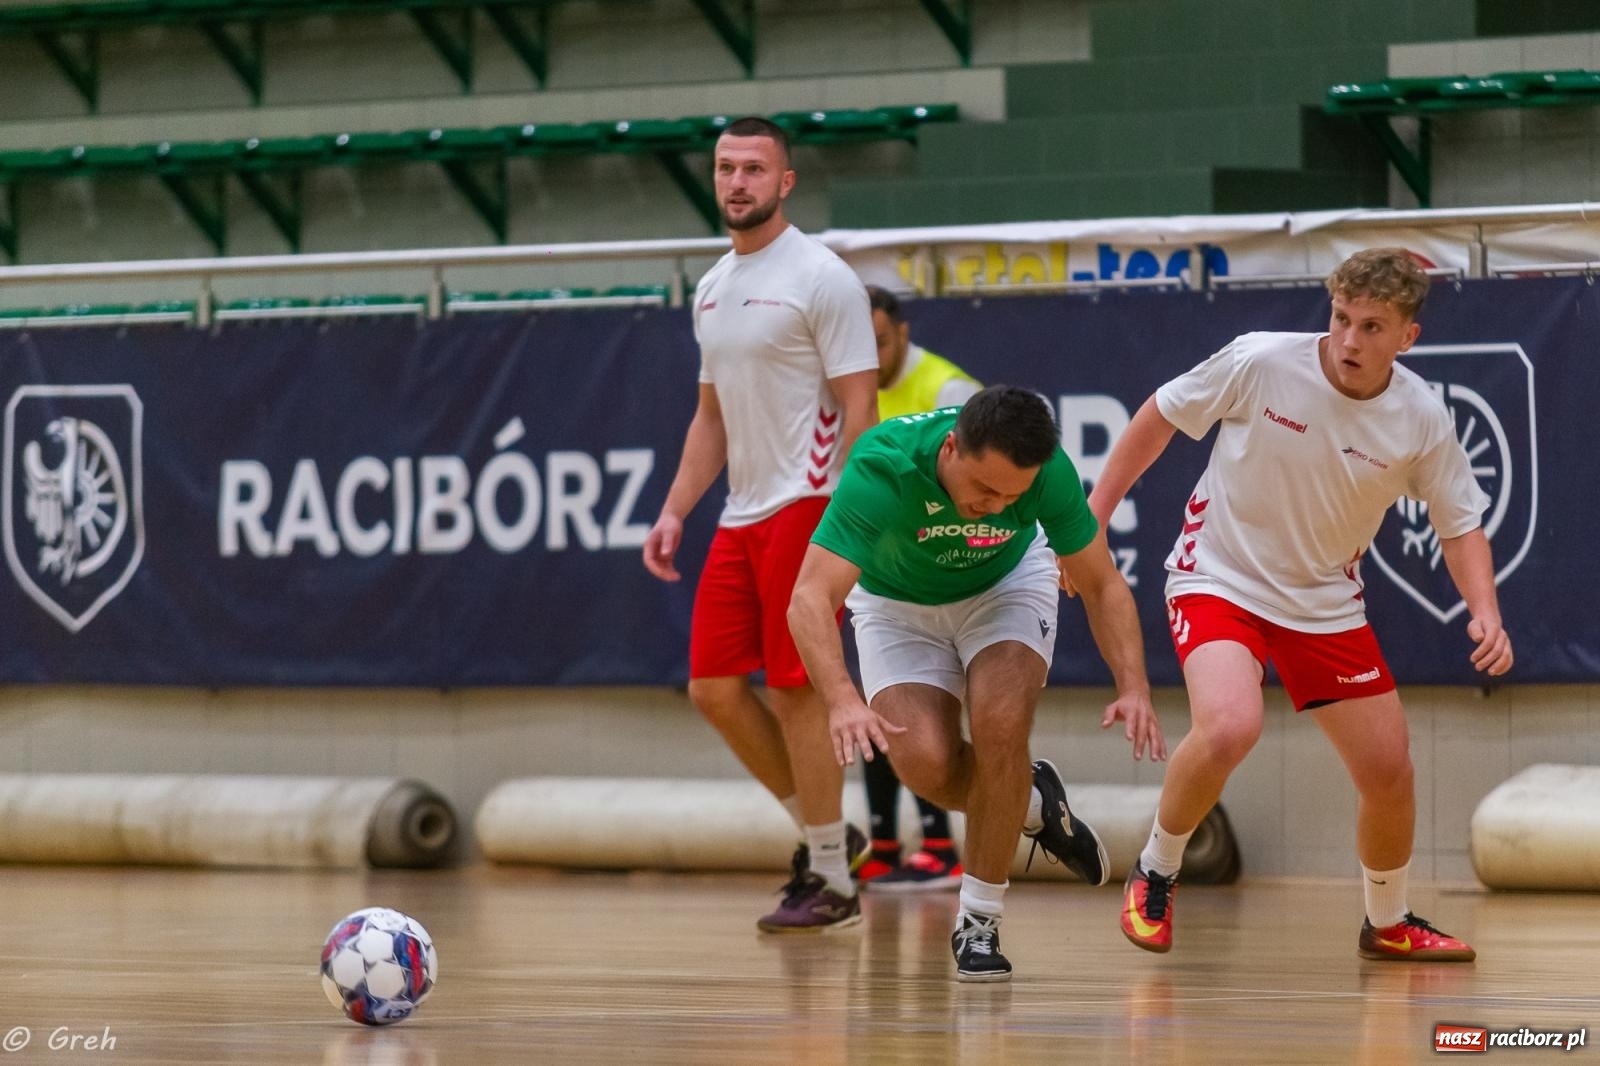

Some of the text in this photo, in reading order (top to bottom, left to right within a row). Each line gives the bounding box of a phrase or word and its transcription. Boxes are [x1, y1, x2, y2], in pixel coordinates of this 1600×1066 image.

[1263, 406, 1309, 434] hummel
[218, 416, 655, 558] RACIBÓRZ
[1336, 666, 1381, 684] hummel
